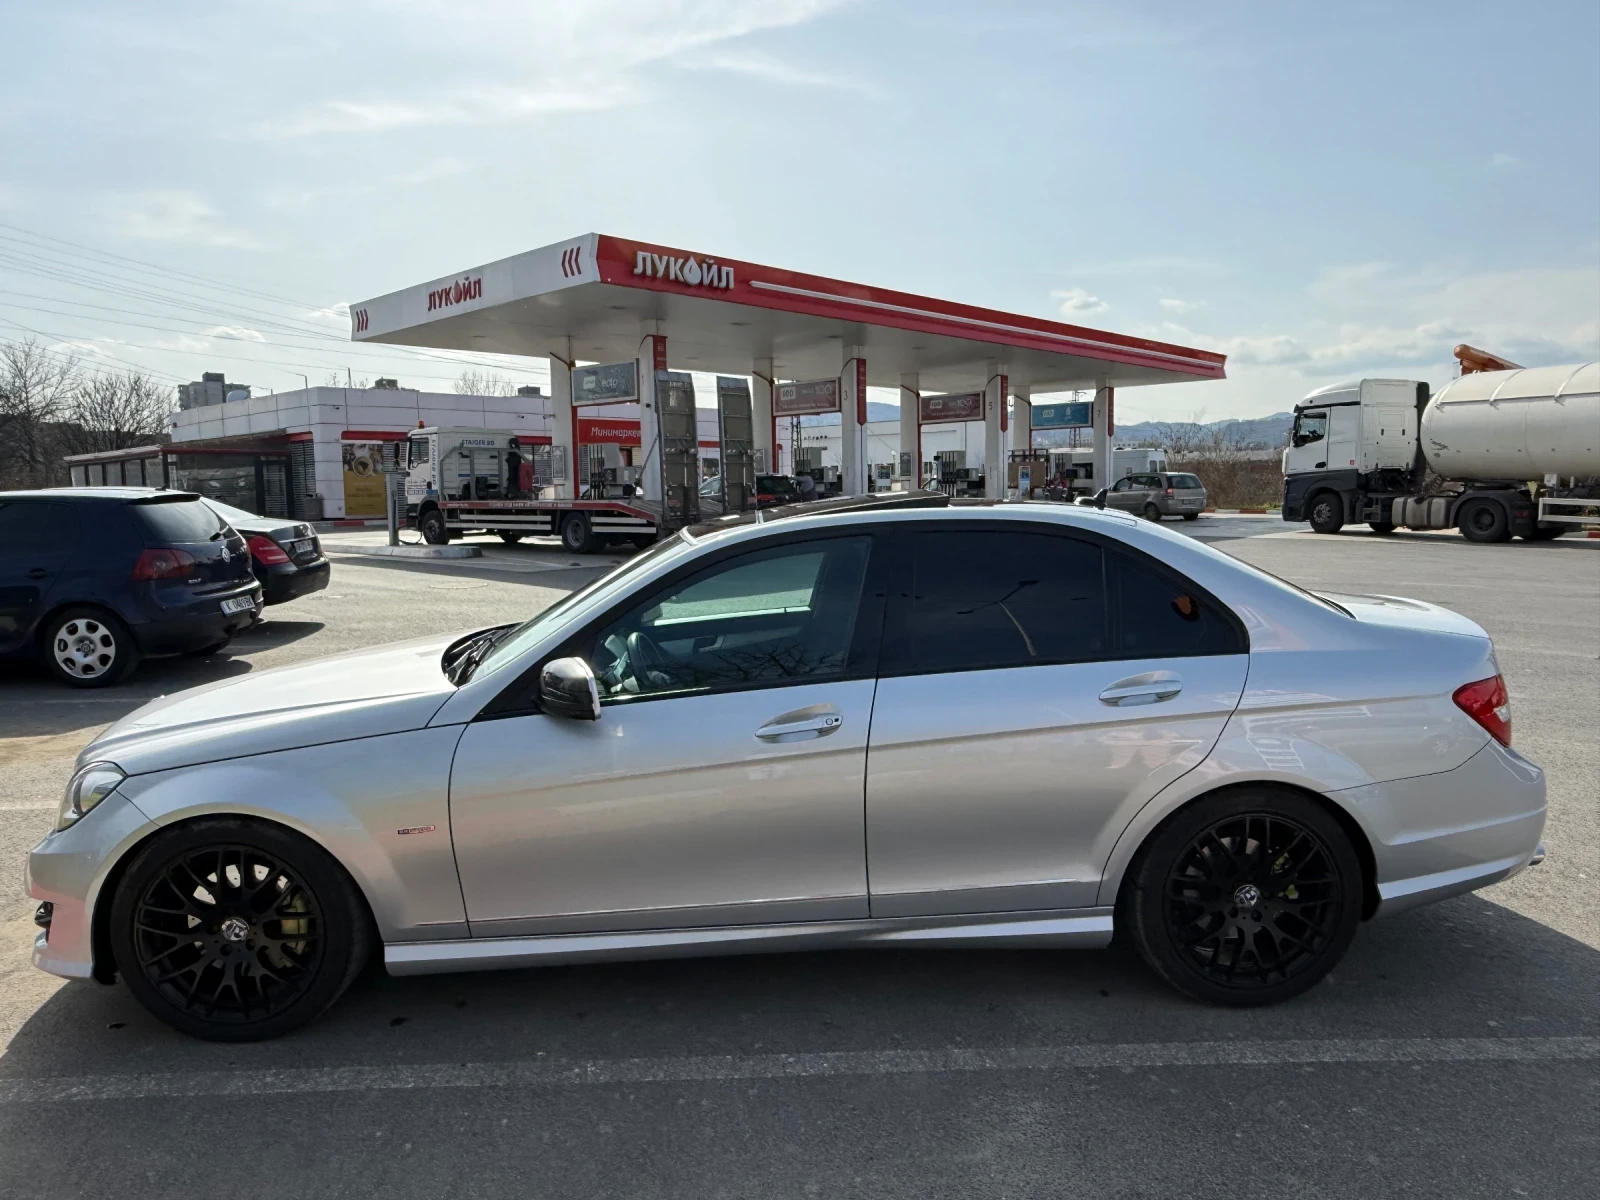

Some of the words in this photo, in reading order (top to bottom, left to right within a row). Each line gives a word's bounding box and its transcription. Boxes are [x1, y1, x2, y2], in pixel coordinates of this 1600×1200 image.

[634, 250, 734, 290] ЛУКОЙЛ
[428, 276, 482, 311] ЛУКОЙЛ
[843, 390, 849, 401] 3
[988, 401, 993, 411] 5
